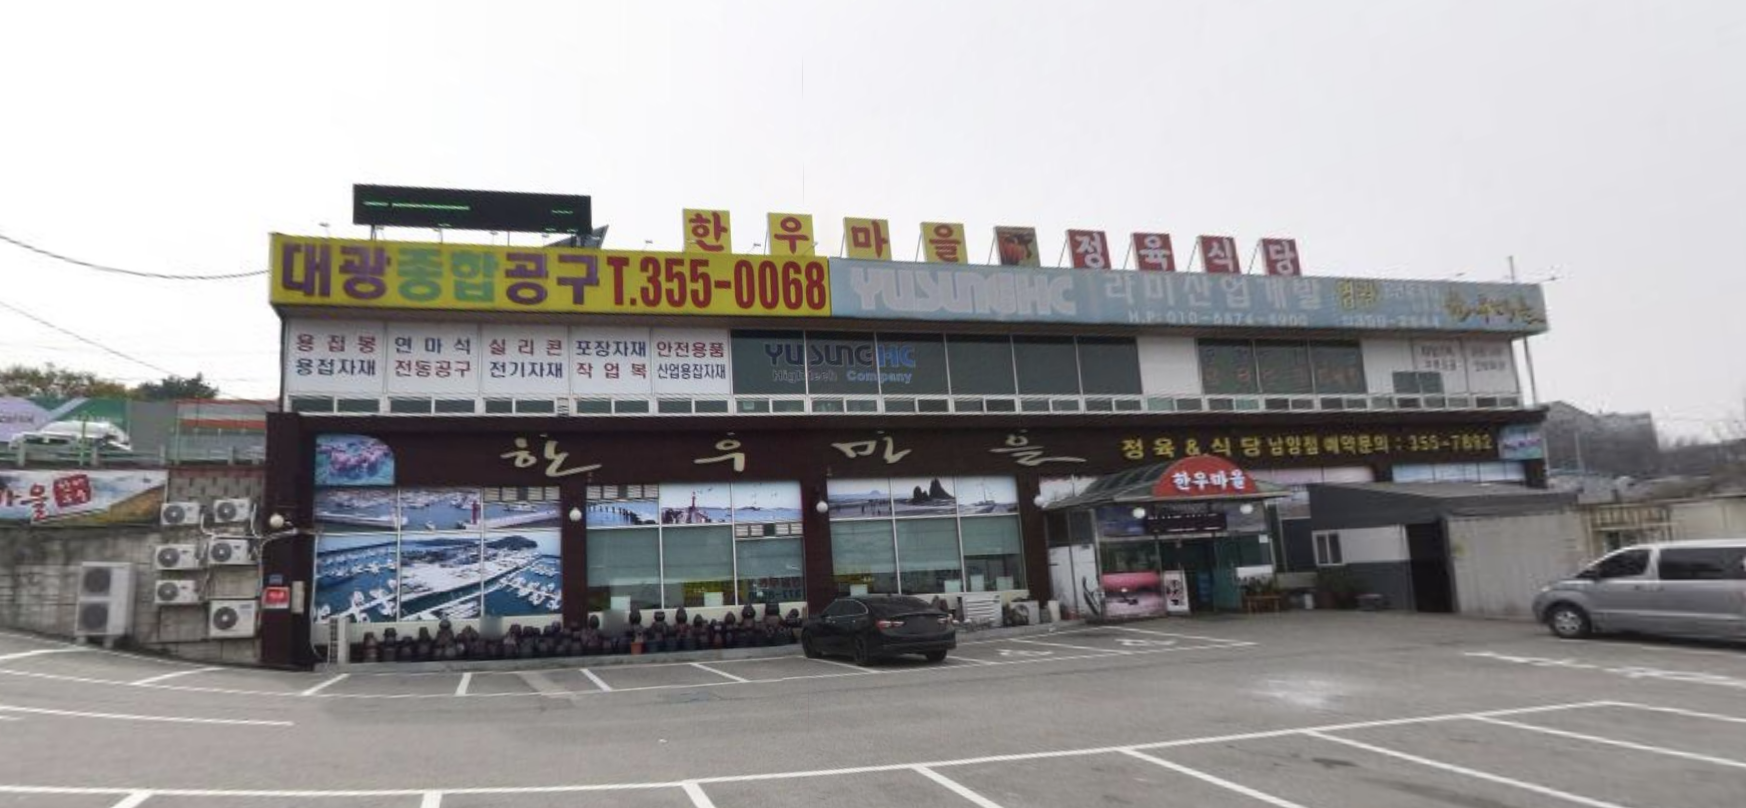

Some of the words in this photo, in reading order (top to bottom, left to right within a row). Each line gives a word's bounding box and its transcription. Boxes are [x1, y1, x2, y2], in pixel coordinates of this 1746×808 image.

[281, 241, 600, 306] 대광종합공구
[606, 255, 827, 310] T.355-0068
[576, 340, 647, 358] 포장자재
[656, 341, 724, 358] 안전용품
[295, 358, 376, 377] 용접자재
[394, 360, 471, 379] 전동공구
[489, 361, 563, 379] 전기자재
[1172, 469, 1246, 492] 한우마을
